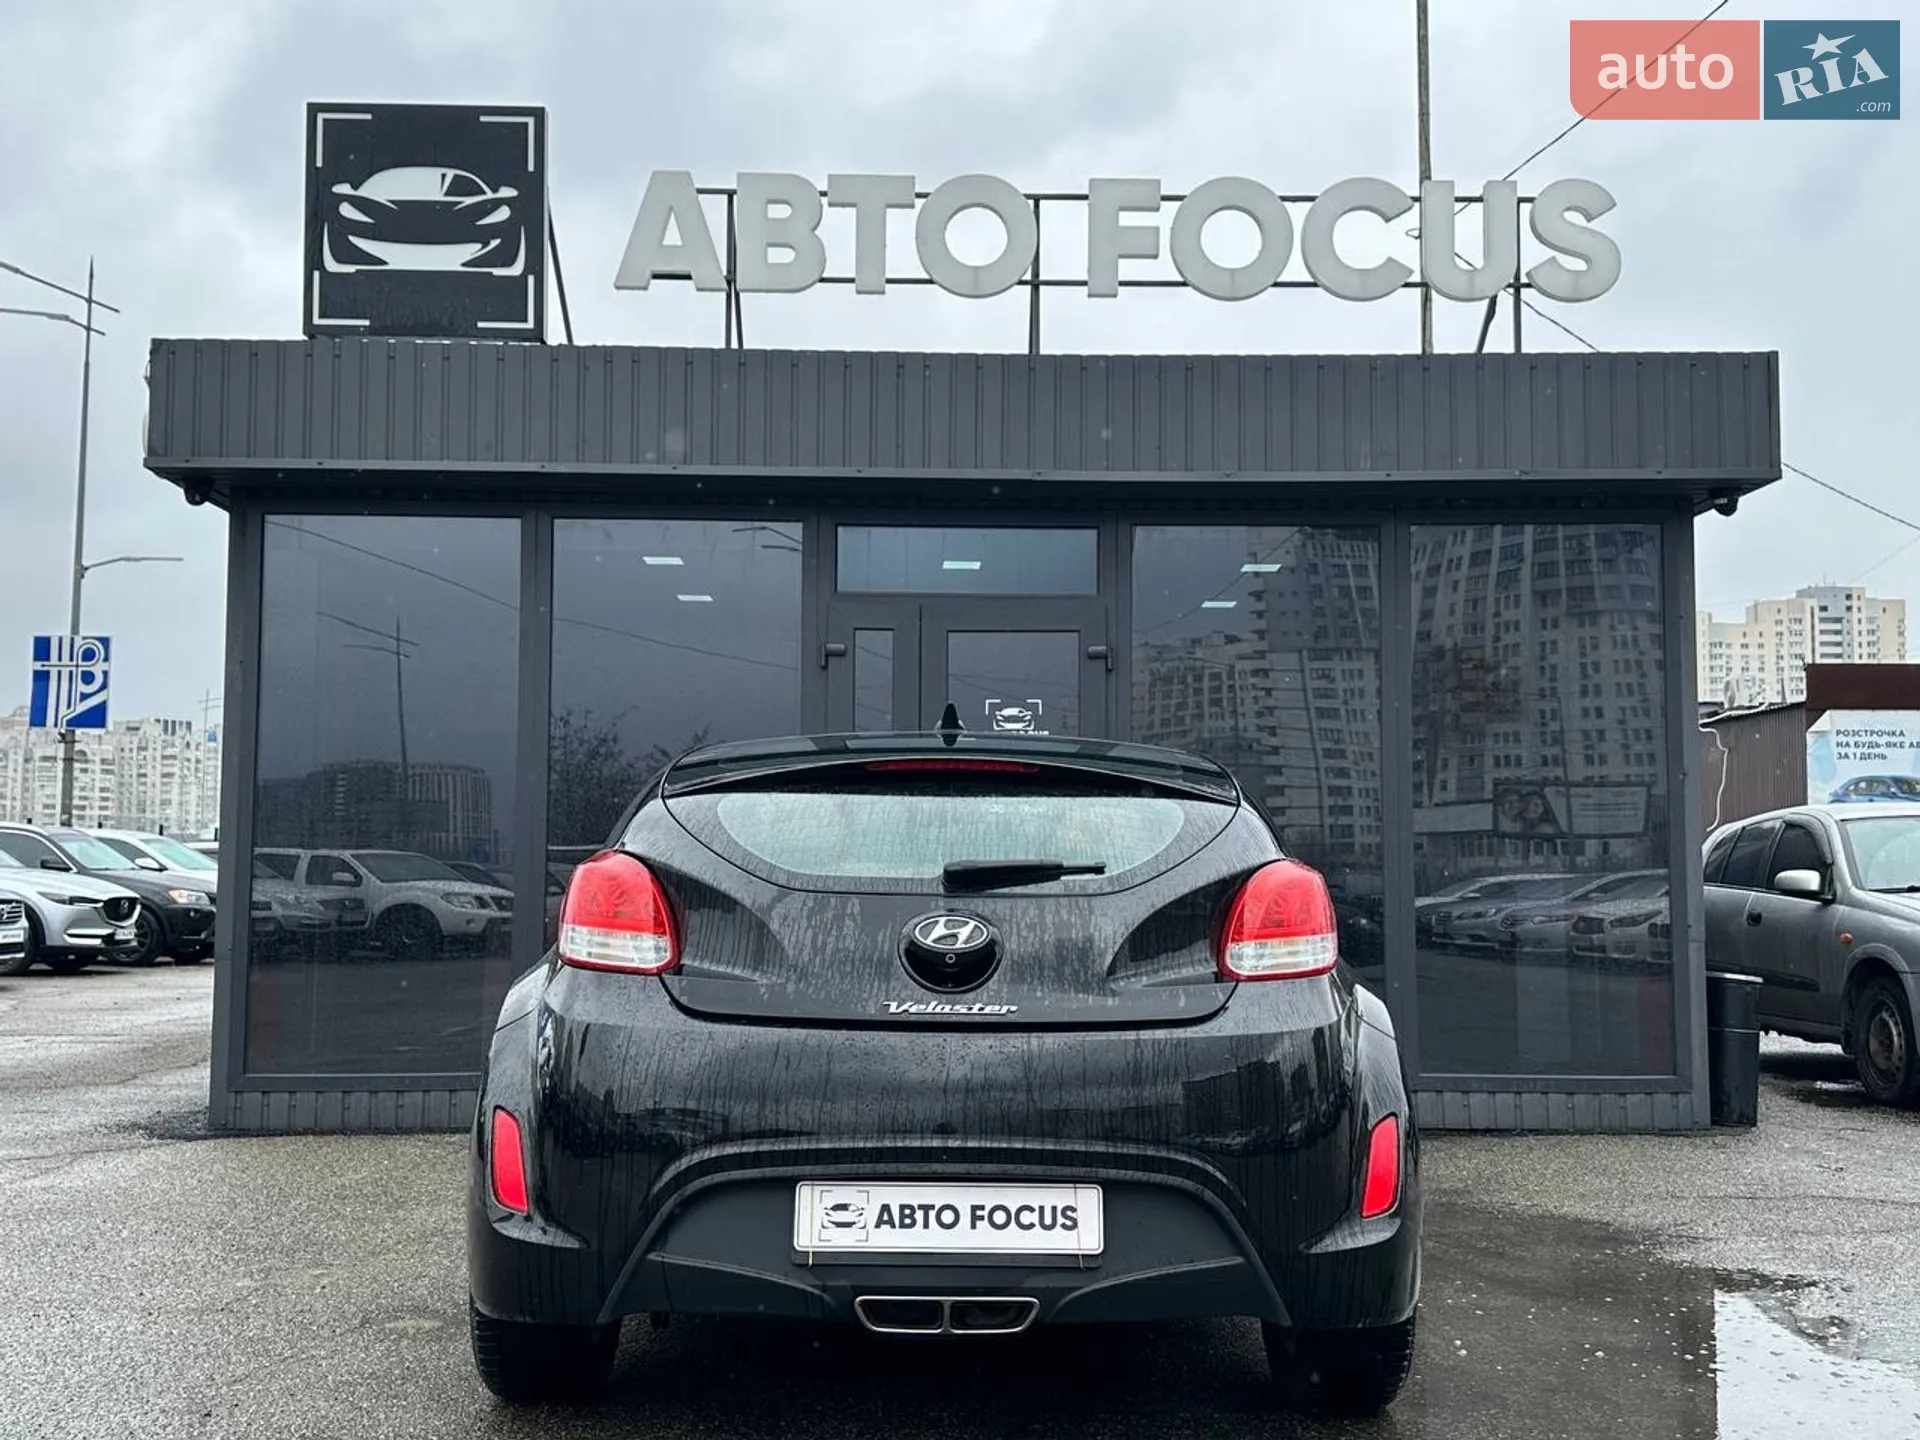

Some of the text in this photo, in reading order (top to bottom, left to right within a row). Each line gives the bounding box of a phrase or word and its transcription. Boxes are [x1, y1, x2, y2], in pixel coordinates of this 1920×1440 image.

[614, 170, 1622, 302] АВТО FOCUS
[1836, 729, 1905, 737] РОЗСТРОЧКА
[1836, 741, 1851, 749] НА
[1836, 752, 1850, 760] ЗА
[1859, 751, 1888, 761] ДЕНЬ
[883, 1001, 1019, 1016] Veloster
[874, 1203, 1078, 1231] АВТО FOCUS
